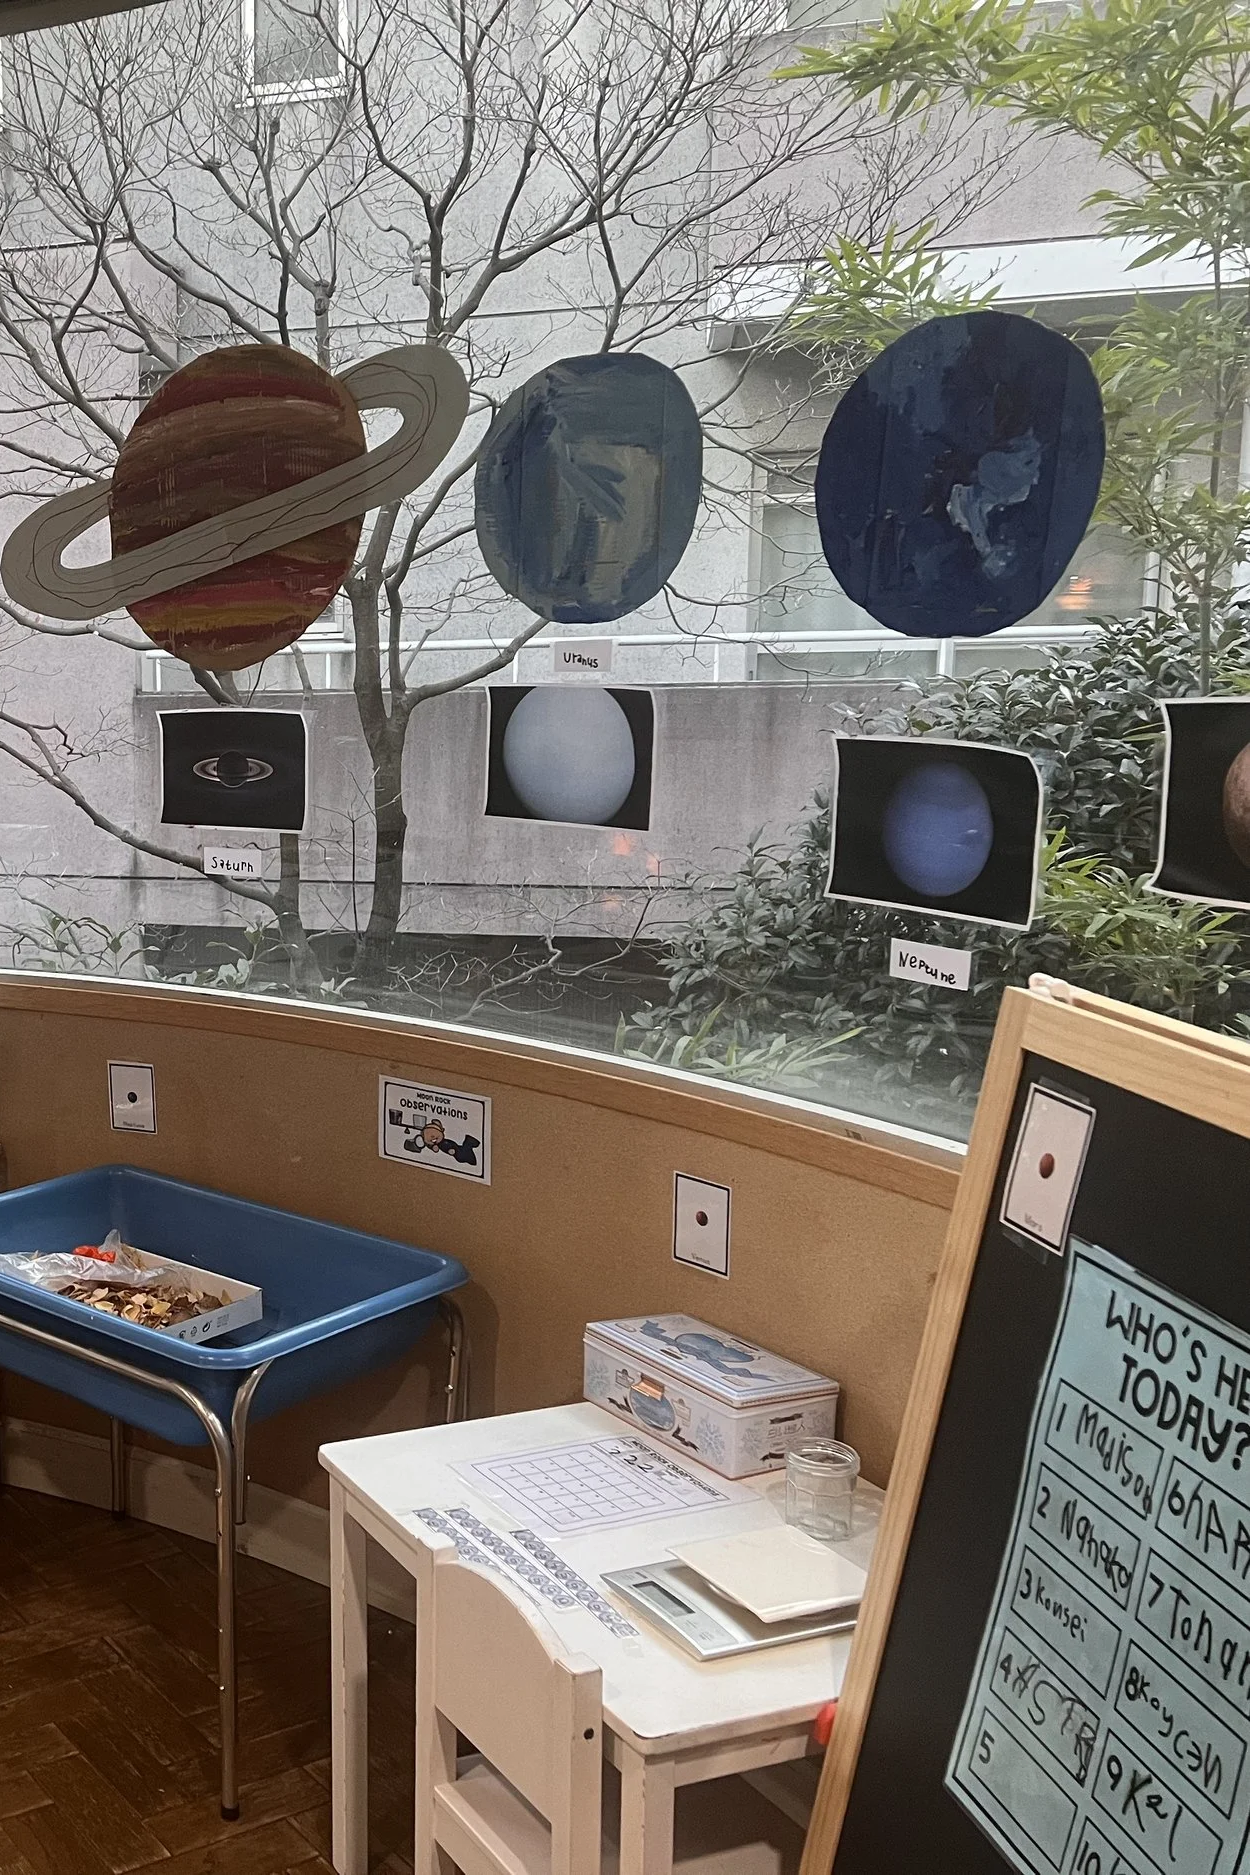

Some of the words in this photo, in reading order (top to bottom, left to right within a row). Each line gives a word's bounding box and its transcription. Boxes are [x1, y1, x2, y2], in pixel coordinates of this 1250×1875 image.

[211, 856, 254, 873] Saturn
[898, 950, 957, 985] Neptune
[1105, 1289, 1208, 1383] WHO'S
[978, 1730, 995, 1765] 5
